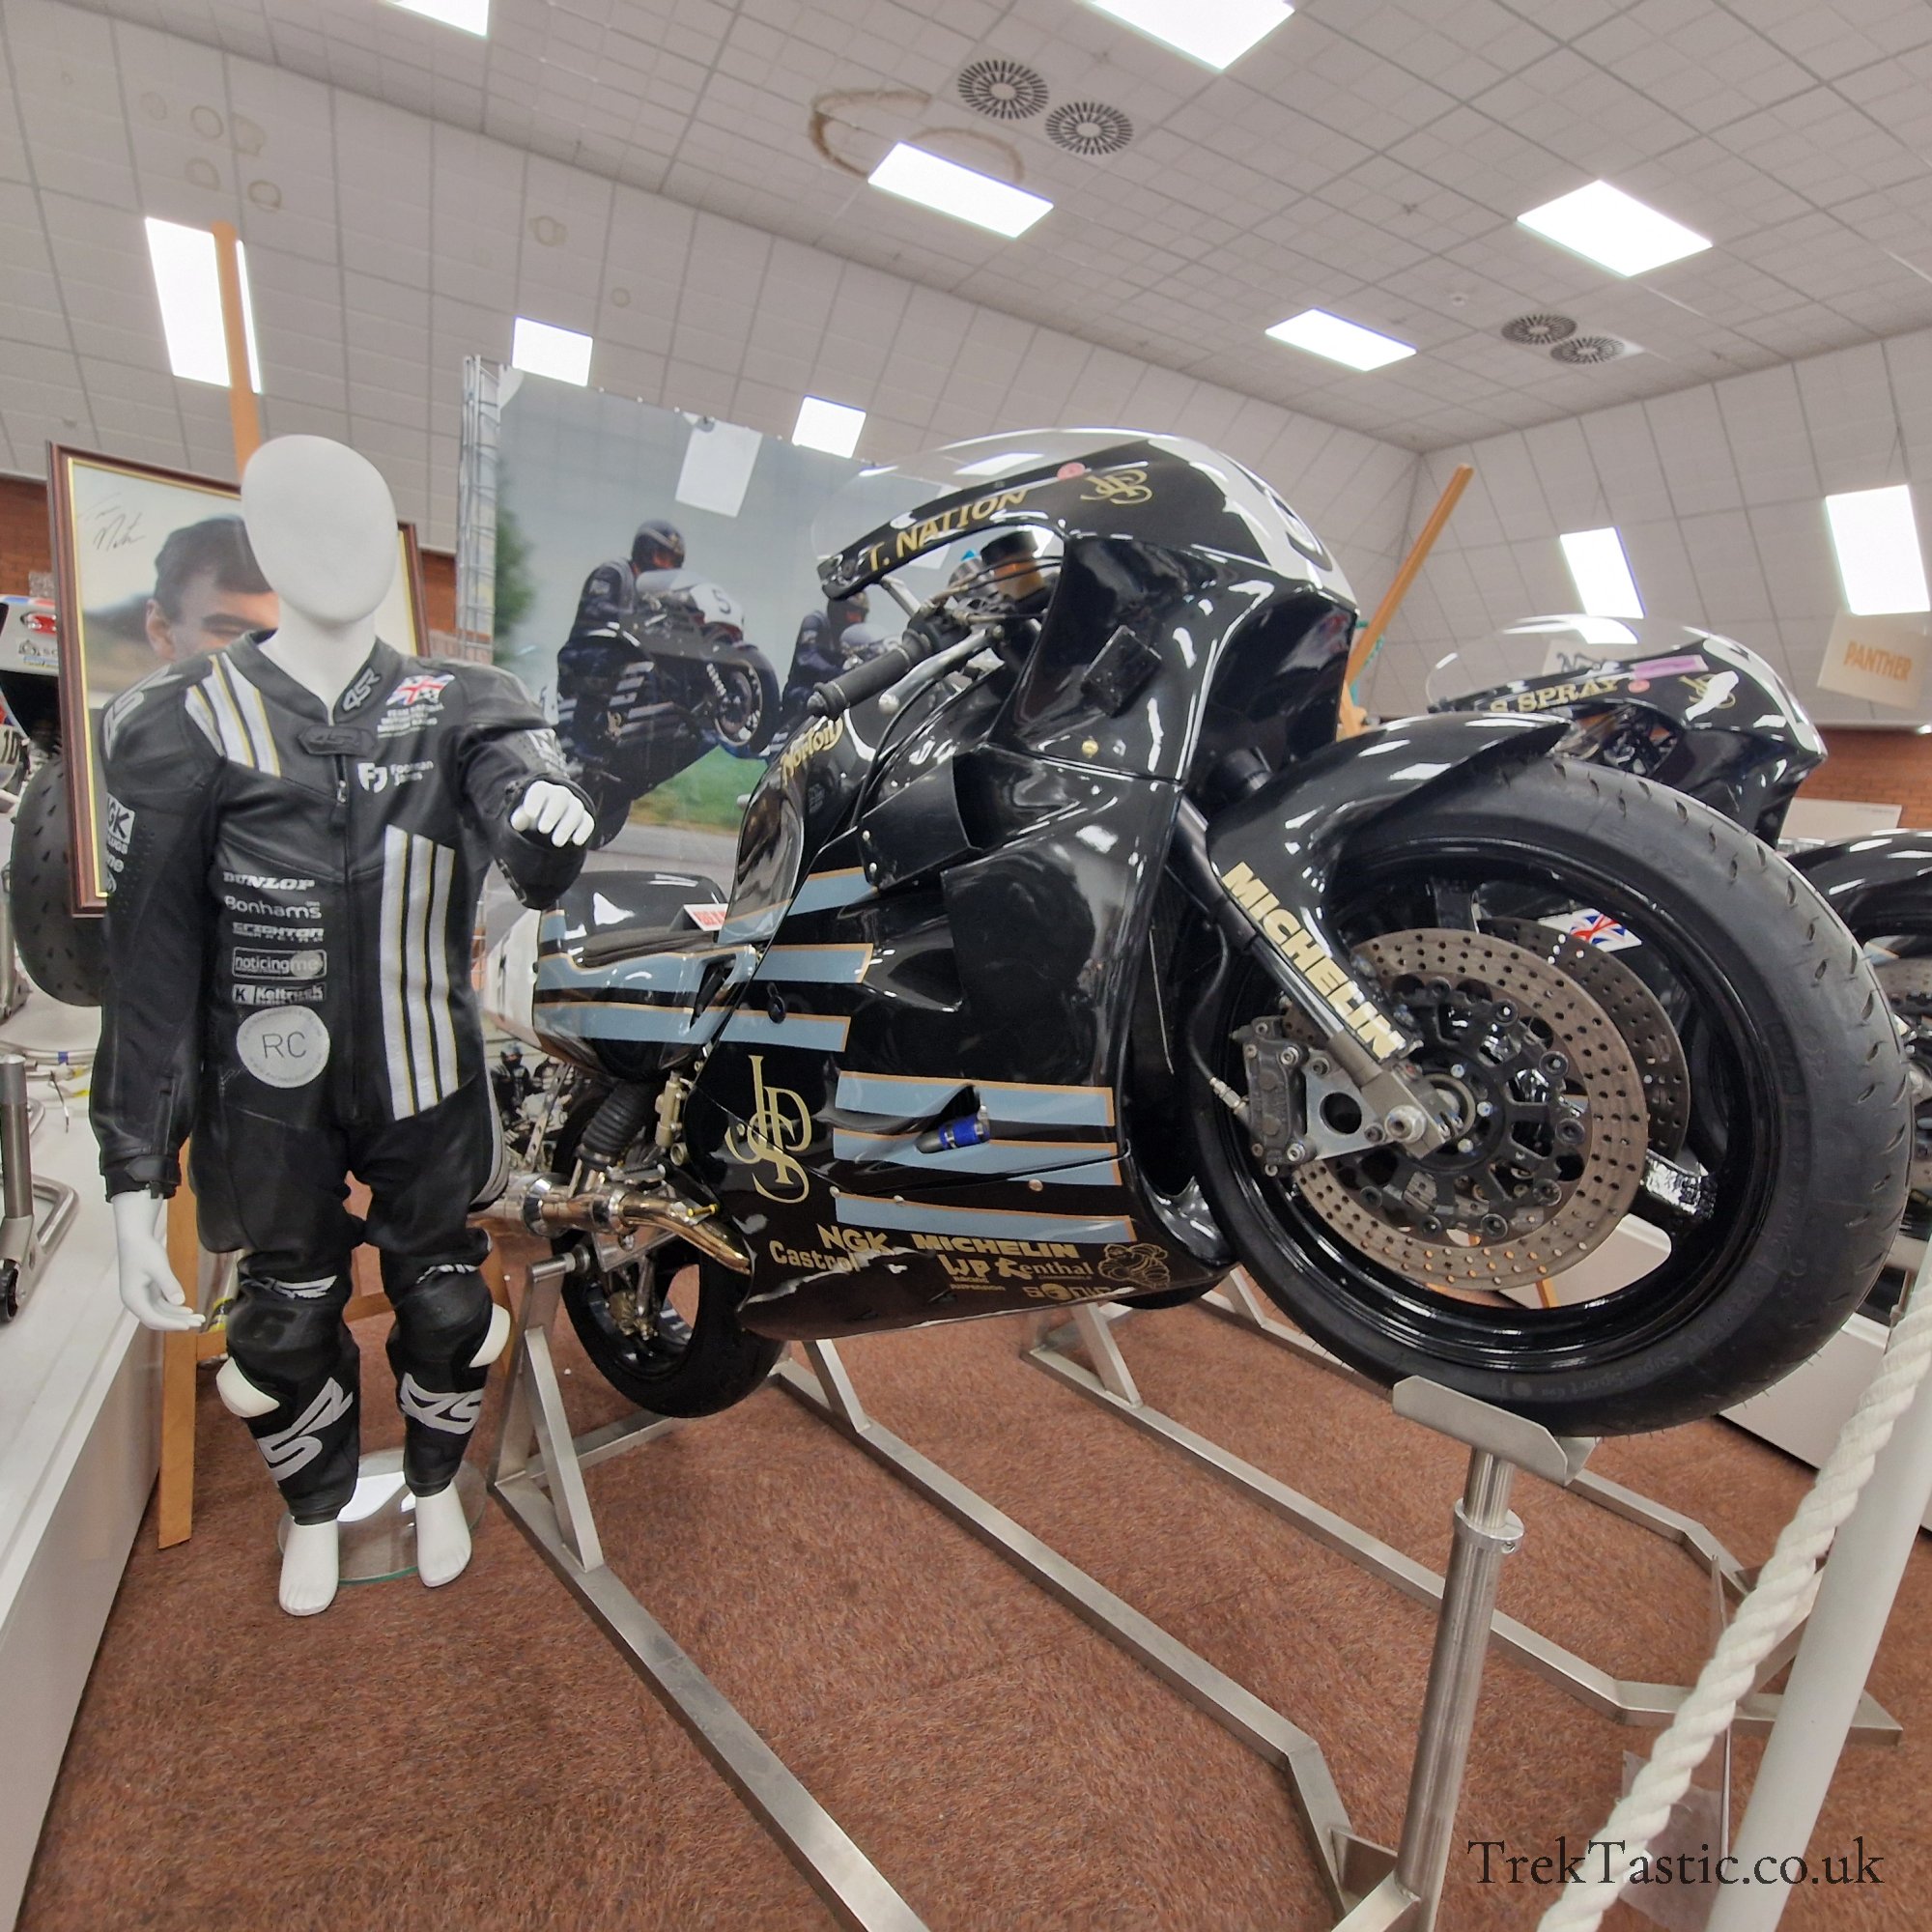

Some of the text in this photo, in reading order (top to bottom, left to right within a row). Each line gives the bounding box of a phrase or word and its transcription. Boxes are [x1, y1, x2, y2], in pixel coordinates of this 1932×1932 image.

[868, 489, 1029, 572] T. NATION
[1842, 640, 1913, 681] PANTHER
[343, 667, 381, 712] 4SR
[1518, 678, 1619, 713] SPRAY
[107, 798, 131, 839] GK
[223, 870, 316, 891] DUNLOP
[223, 895, 323, 920] Bonhams
[1221, 862, 1406, 1061] MICHELIN
[262, 1031, 307, 1059] RC
[769, 1239, 861, 1273] Castrol
[816, 1223, 895, 1257] NGK
[911, 1233, 1081, 1259] MICHELIN
[937, 1254, 991, 1278] WP
